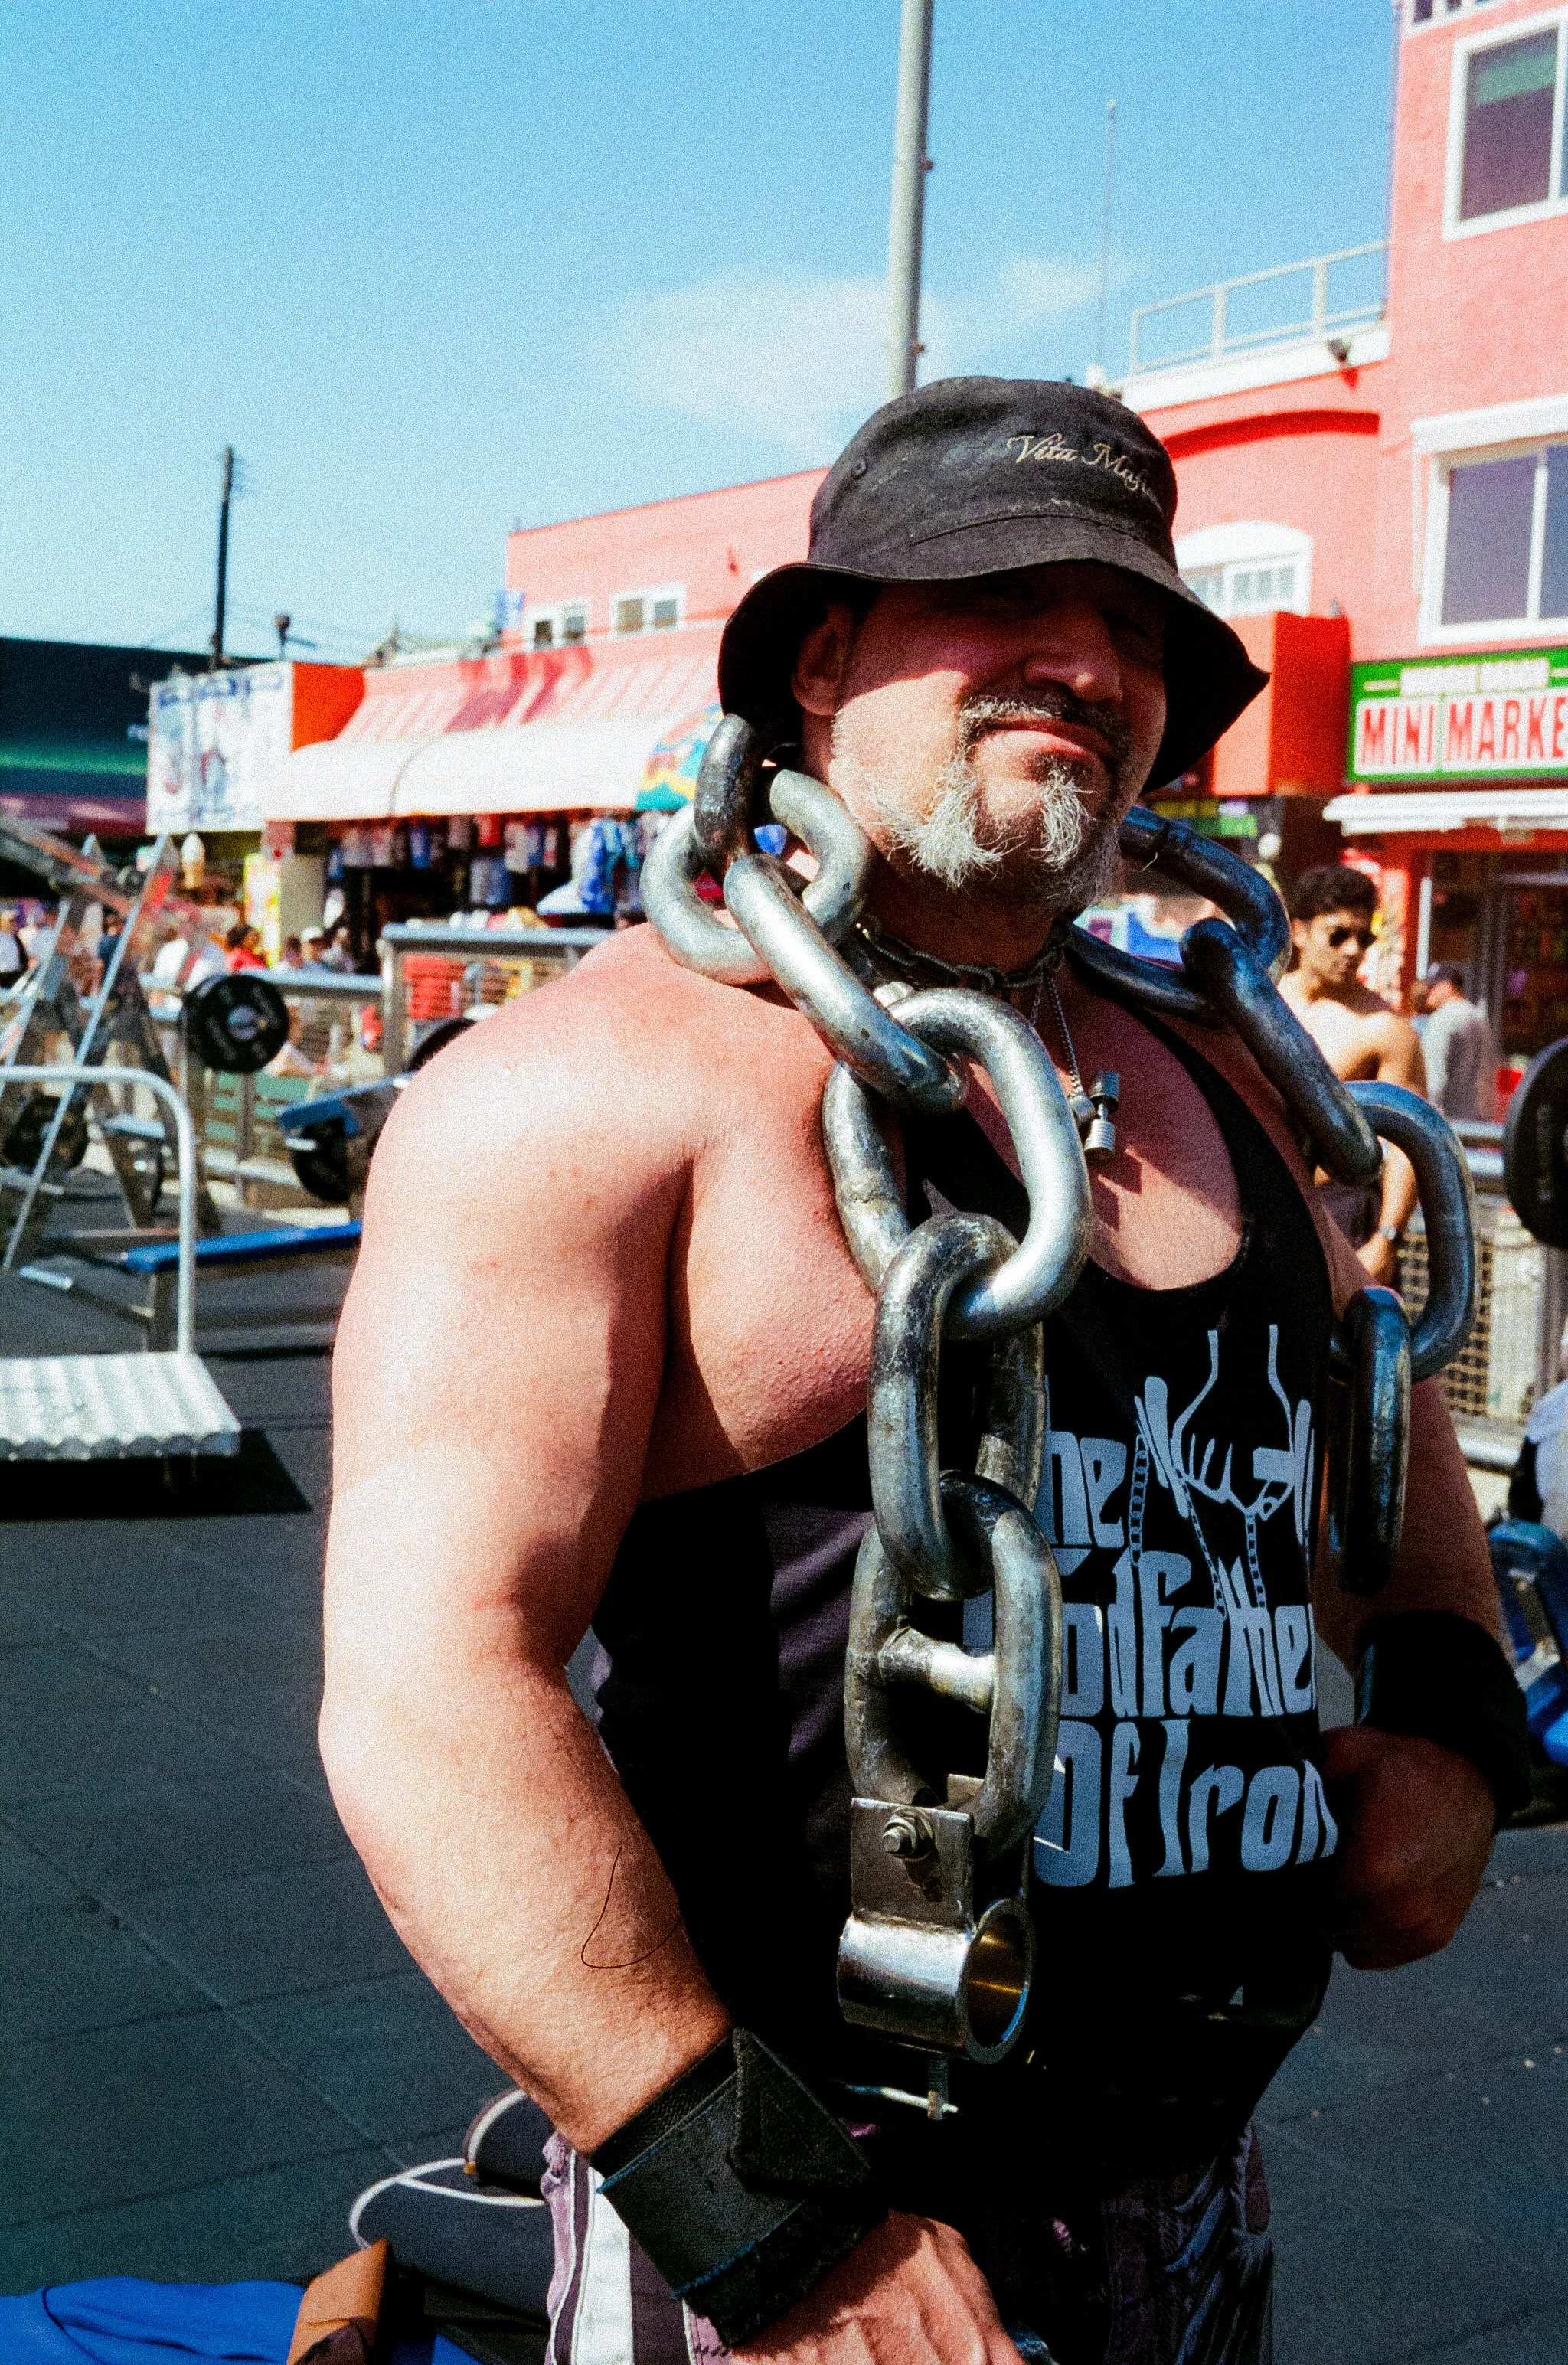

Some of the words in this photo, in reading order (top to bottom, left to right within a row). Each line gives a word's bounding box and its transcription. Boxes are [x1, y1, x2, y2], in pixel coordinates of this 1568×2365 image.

[1361, 704, 1434, 766] MINI
[1446, 695, 1568, 762] MARKE
[1032, 1374, 1127, 1549] he
[962, 1545, 1317, 1719] odfathe
[1033, 1720, 1141, 1889] Of
[1152, 1718, 1339, 1877] Iron
